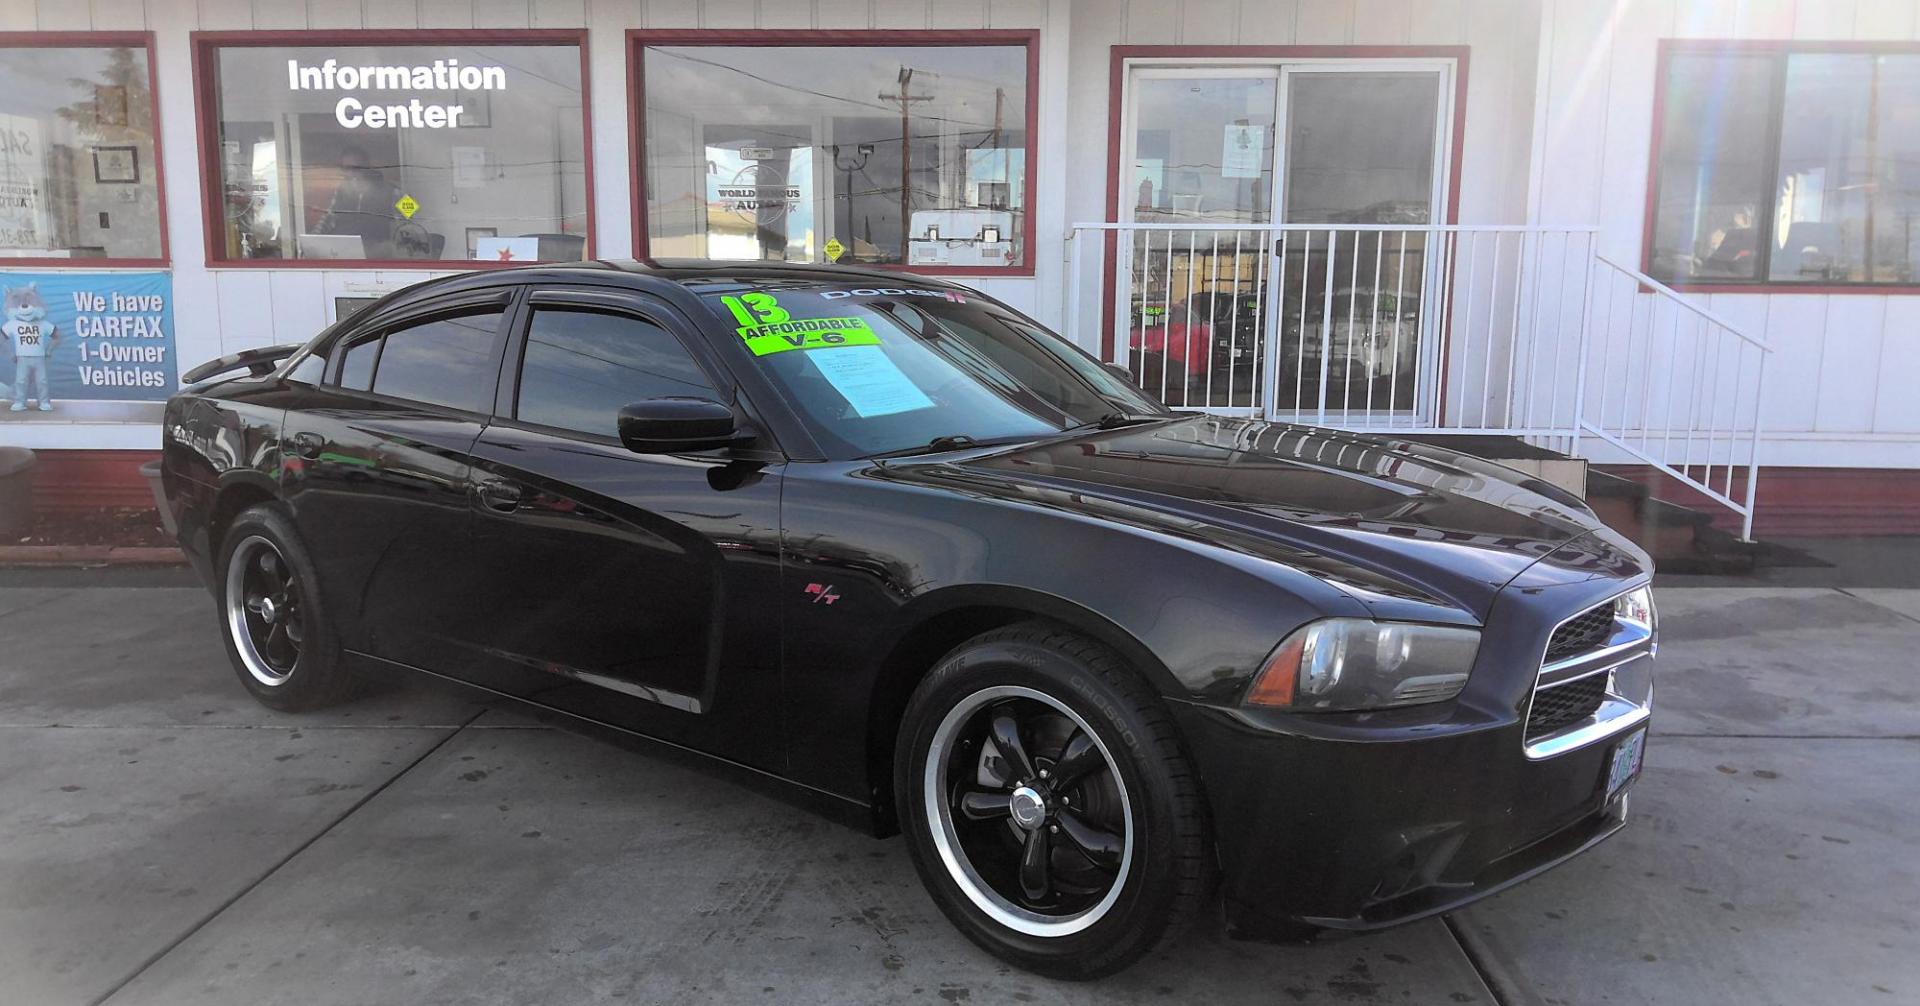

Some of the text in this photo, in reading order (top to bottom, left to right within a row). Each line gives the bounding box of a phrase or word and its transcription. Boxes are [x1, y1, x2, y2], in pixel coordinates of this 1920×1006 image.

[288, 58, 506, 91] Information
[335, 96, 464, 129] Center
[718, 189, 756, 198] WORLD
[73, 291, 163, 312] We have
[820, 287, 945, 301] DODGE
[720, 291, 792, 327] 13
[17, 325, 40, 335] CAR
[75, 316, 165, 338] CARFAX
[745, 318, 864, 340] AFFORDABLE
[20, 335, 40, 345] FOX
[782, 331, 846, 347] V-6
[78, 341, 166, 363] 1-Owner
[78, 365, 165, 388] Vehicles
[804, 582, 841, 605] R/T
